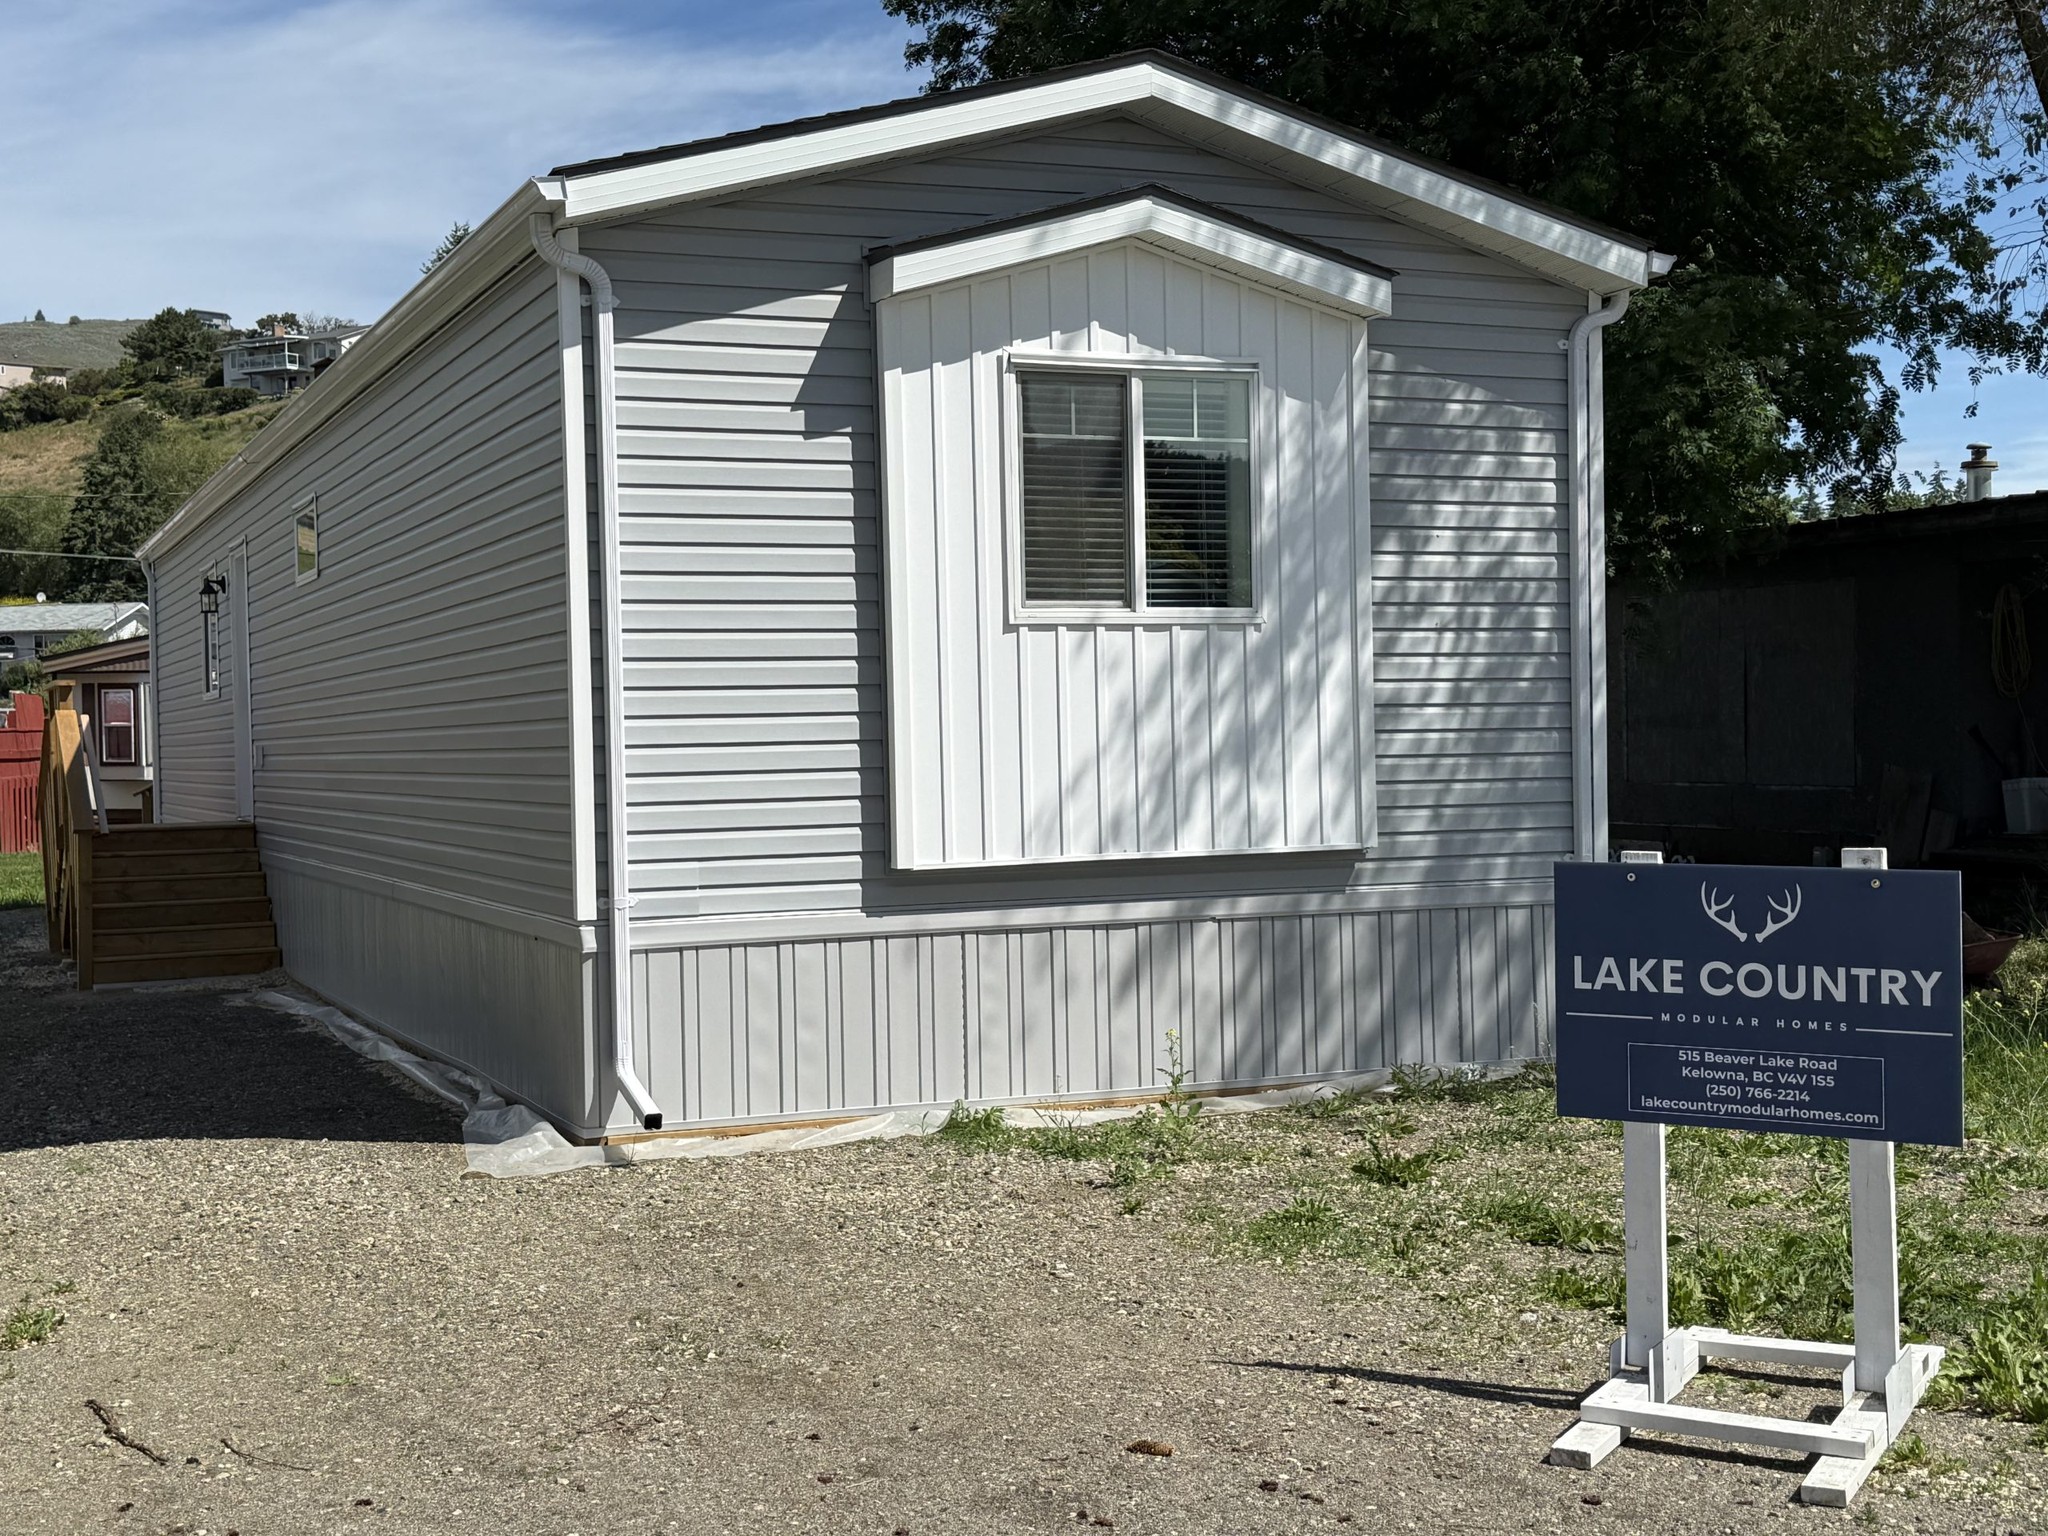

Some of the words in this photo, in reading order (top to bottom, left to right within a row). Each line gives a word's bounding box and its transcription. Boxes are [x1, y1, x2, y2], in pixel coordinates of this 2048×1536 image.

[1573, 955, 1684, 994] LAKE
[1699, 960, 1943, 1007] COUNTRY
[1661, 1012, 1759, 1027] MODULAR
[1776, 1018, 1847, 1032] HOMES
[1678, 1050, 1701, 1062] 515
[1704, 1051, 1756, 1065] Beaver
[1759, 1054, 1795, 1068] Lake
[1799, 1057, 1838, 1071] Road
[1682, 1066, 1749, 1083] Kelowna,
[1752, 1070, 1774, 1083] BC
[1777, 1072, 1808, 1085] V4V
[1810, 1074, 1835, 1087] 1S5
[1705, 1083, 1742, 1100] (250)
[1745, 1086, 1811, 1102] 766-2214
[1641, 1095, 1879, 1124] lakecountrymodularhomes.com
